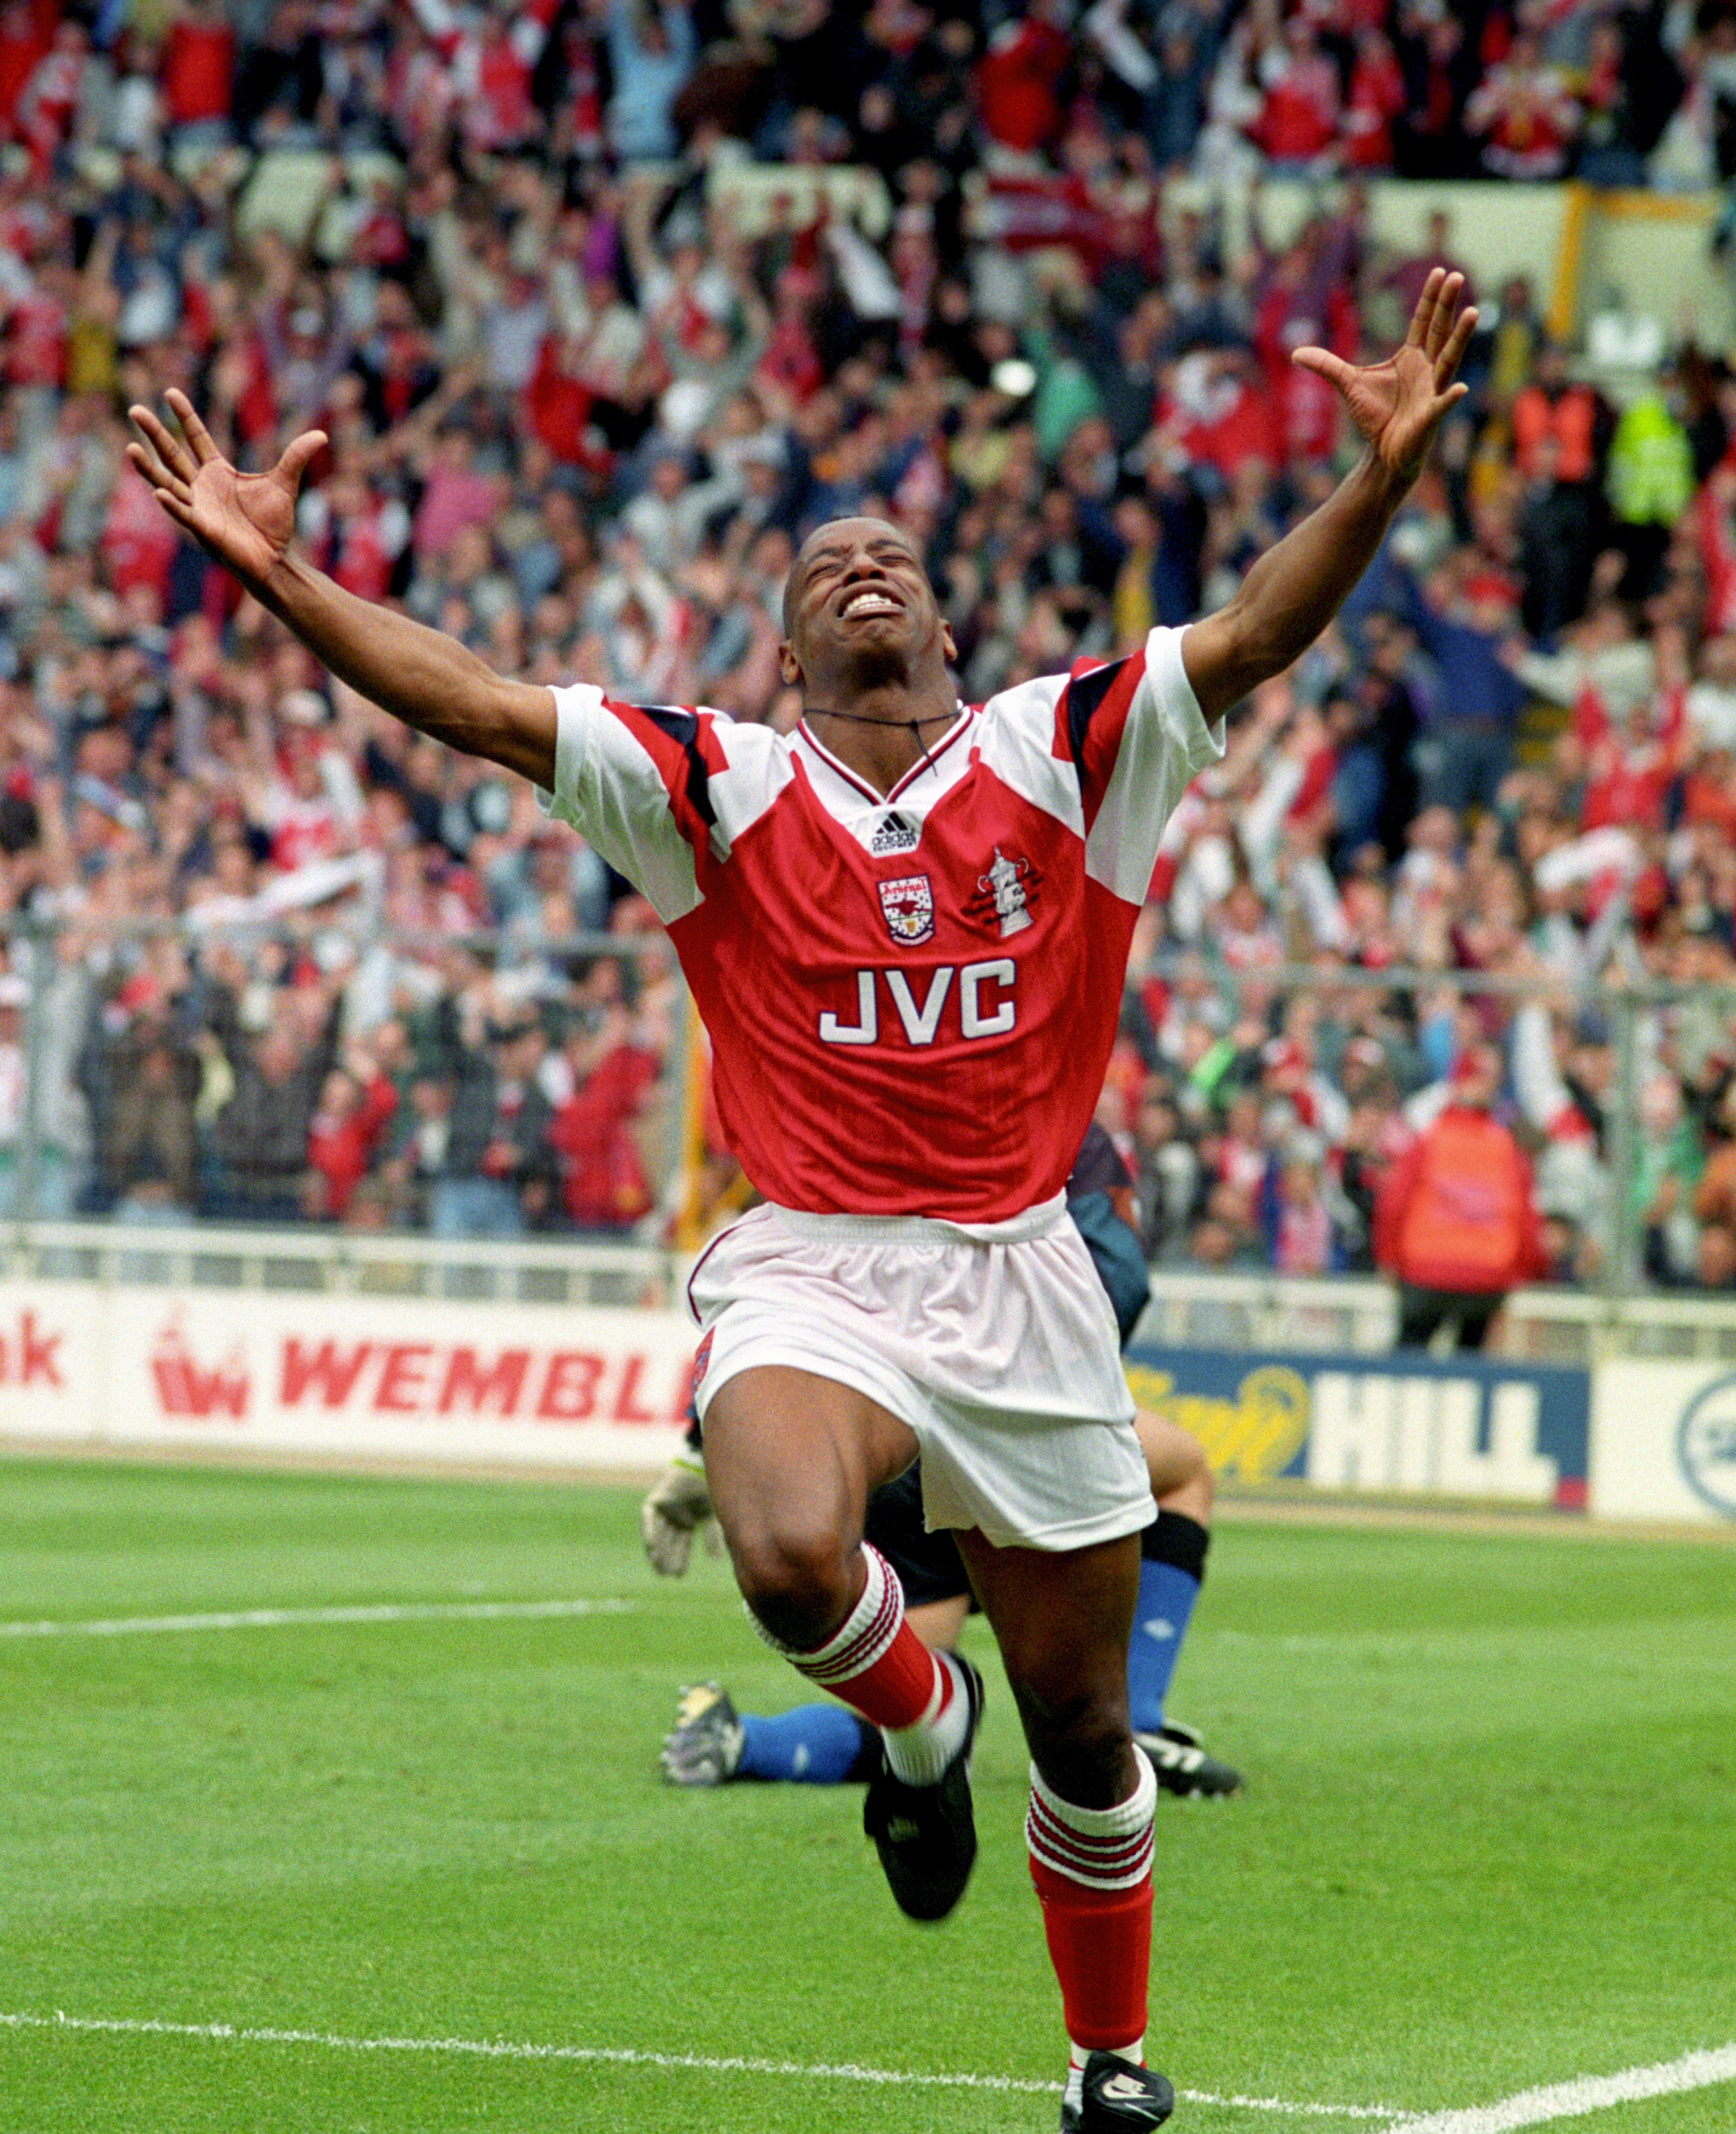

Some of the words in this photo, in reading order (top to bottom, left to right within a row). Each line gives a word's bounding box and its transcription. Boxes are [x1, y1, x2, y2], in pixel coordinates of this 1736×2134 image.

[872, 830, 916, 846] adidas
[882, 878, 927, 895] Arsenal
[819, 958, 1015, 1045] JVC
[1307, 1371, 1560, 1503] HILL
